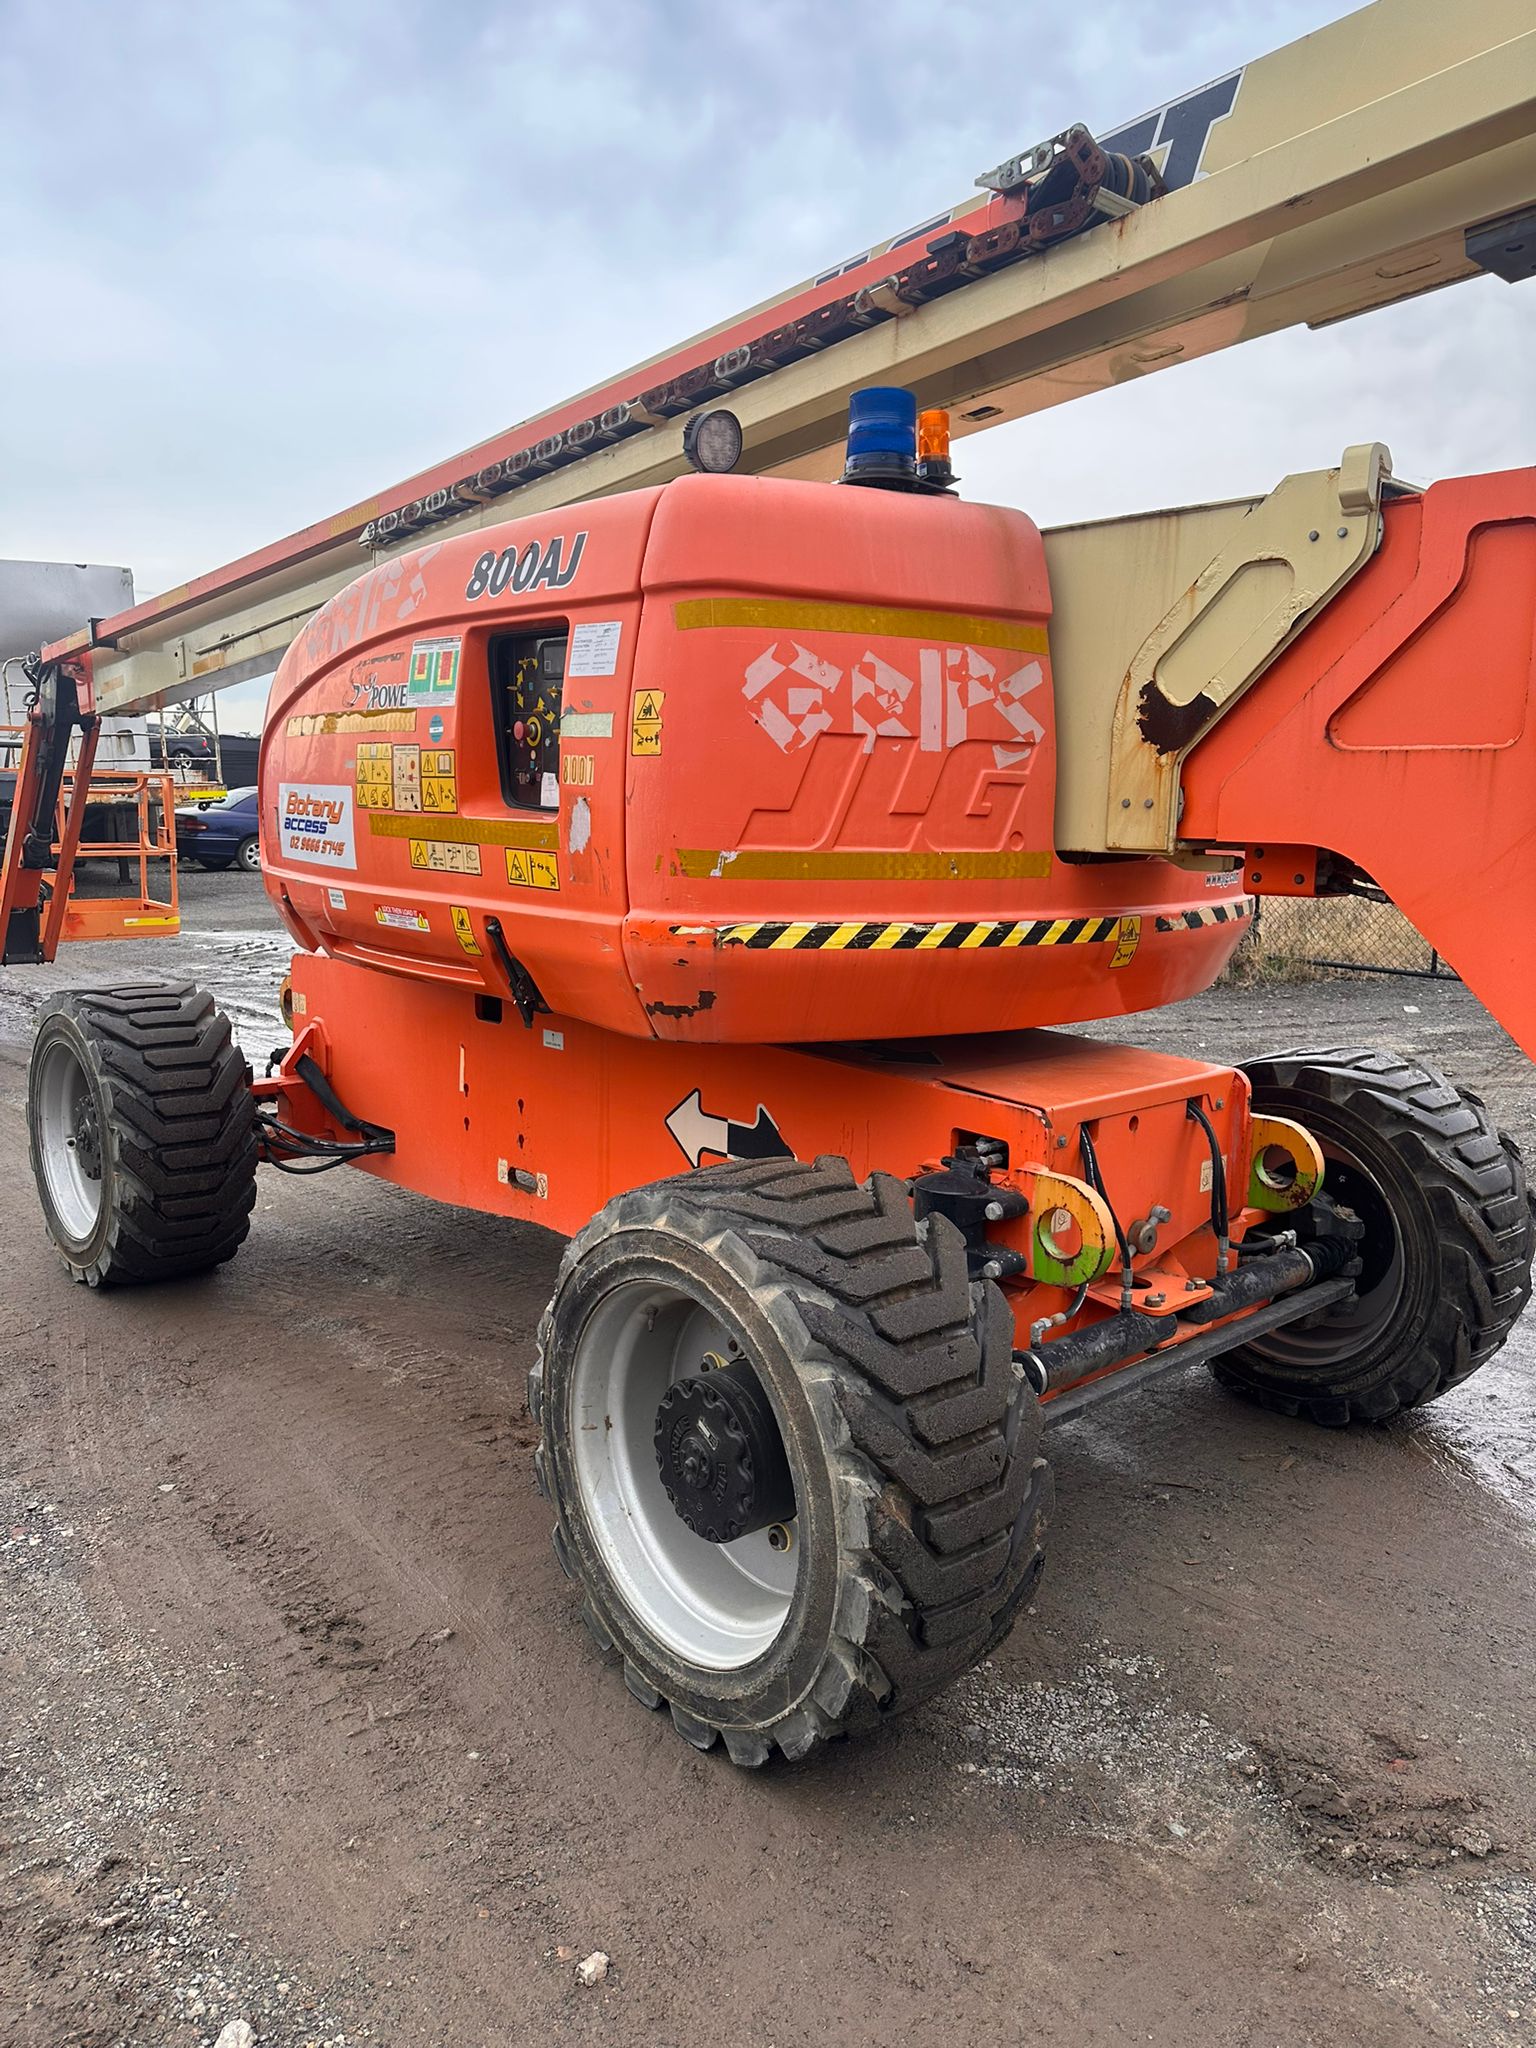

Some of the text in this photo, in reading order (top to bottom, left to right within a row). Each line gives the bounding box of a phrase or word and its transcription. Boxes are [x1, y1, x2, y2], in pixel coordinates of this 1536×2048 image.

[465, 530, 590, 602] 800AJ
[367, 682, 408, 711] POWE
[562, 755, 594, 785] 8007
[736, 731, 1038, 852] JLG
[285, 790, 345, 825] Botany
[283, 817, 328, 835] access
[289, 835, 301, 850] 02
